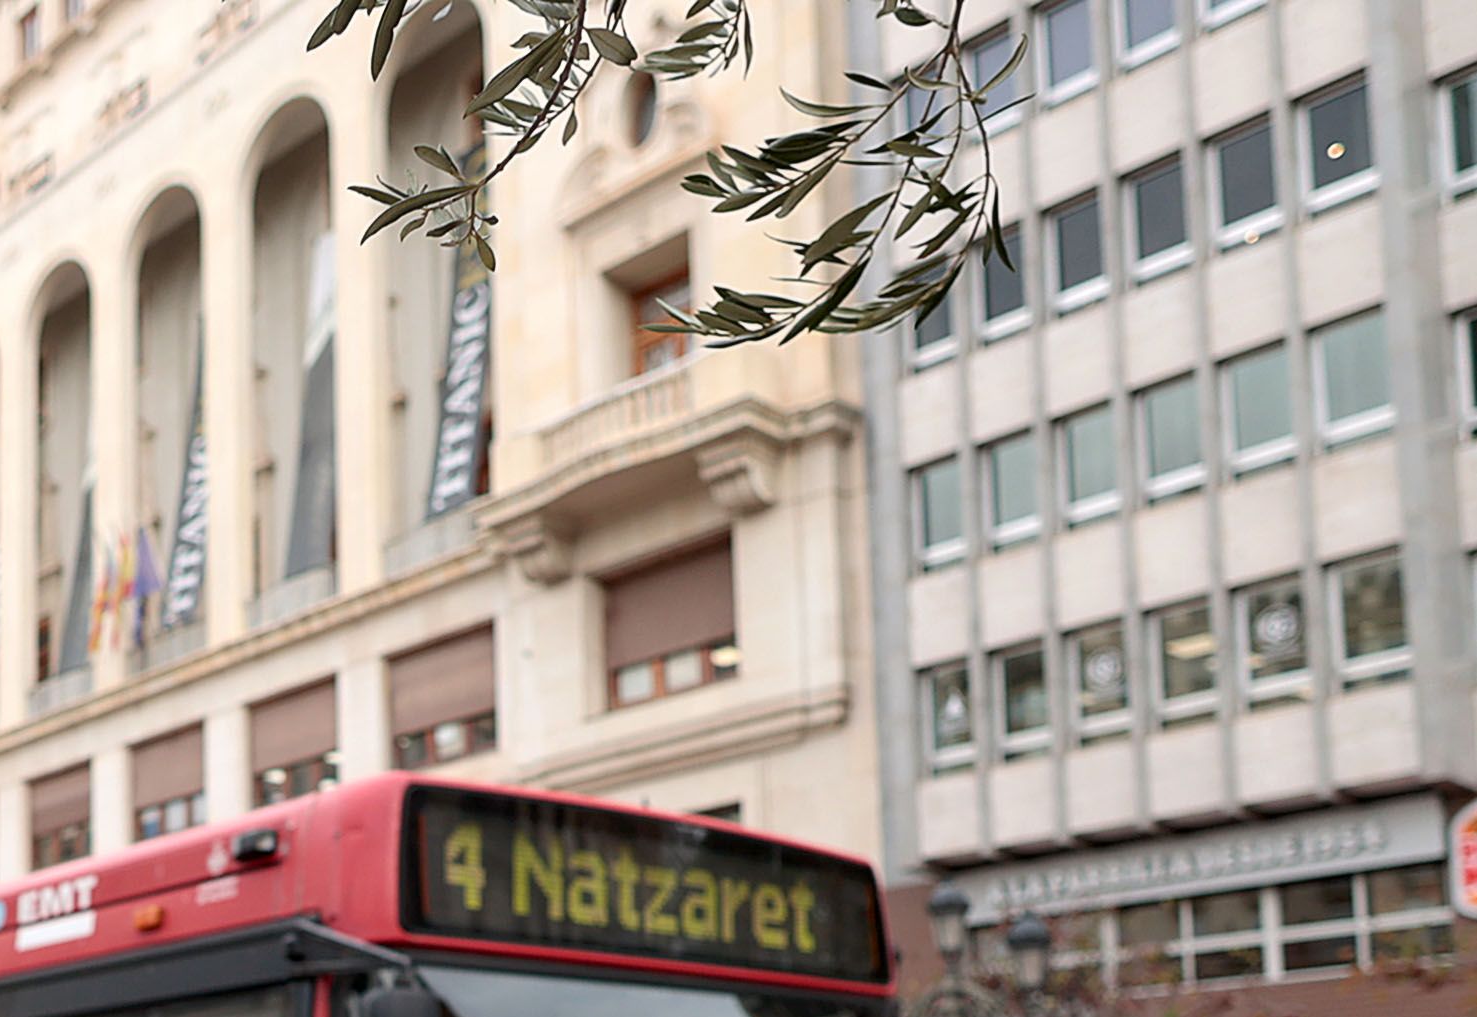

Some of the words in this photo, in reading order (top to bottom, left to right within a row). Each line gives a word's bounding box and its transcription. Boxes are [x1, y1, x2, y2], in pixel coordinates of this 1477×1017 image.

[16, 874, 99, 924] EMT
[443, 822, 486, 911] 4
[513, 825, 817, 954] Natzaret
